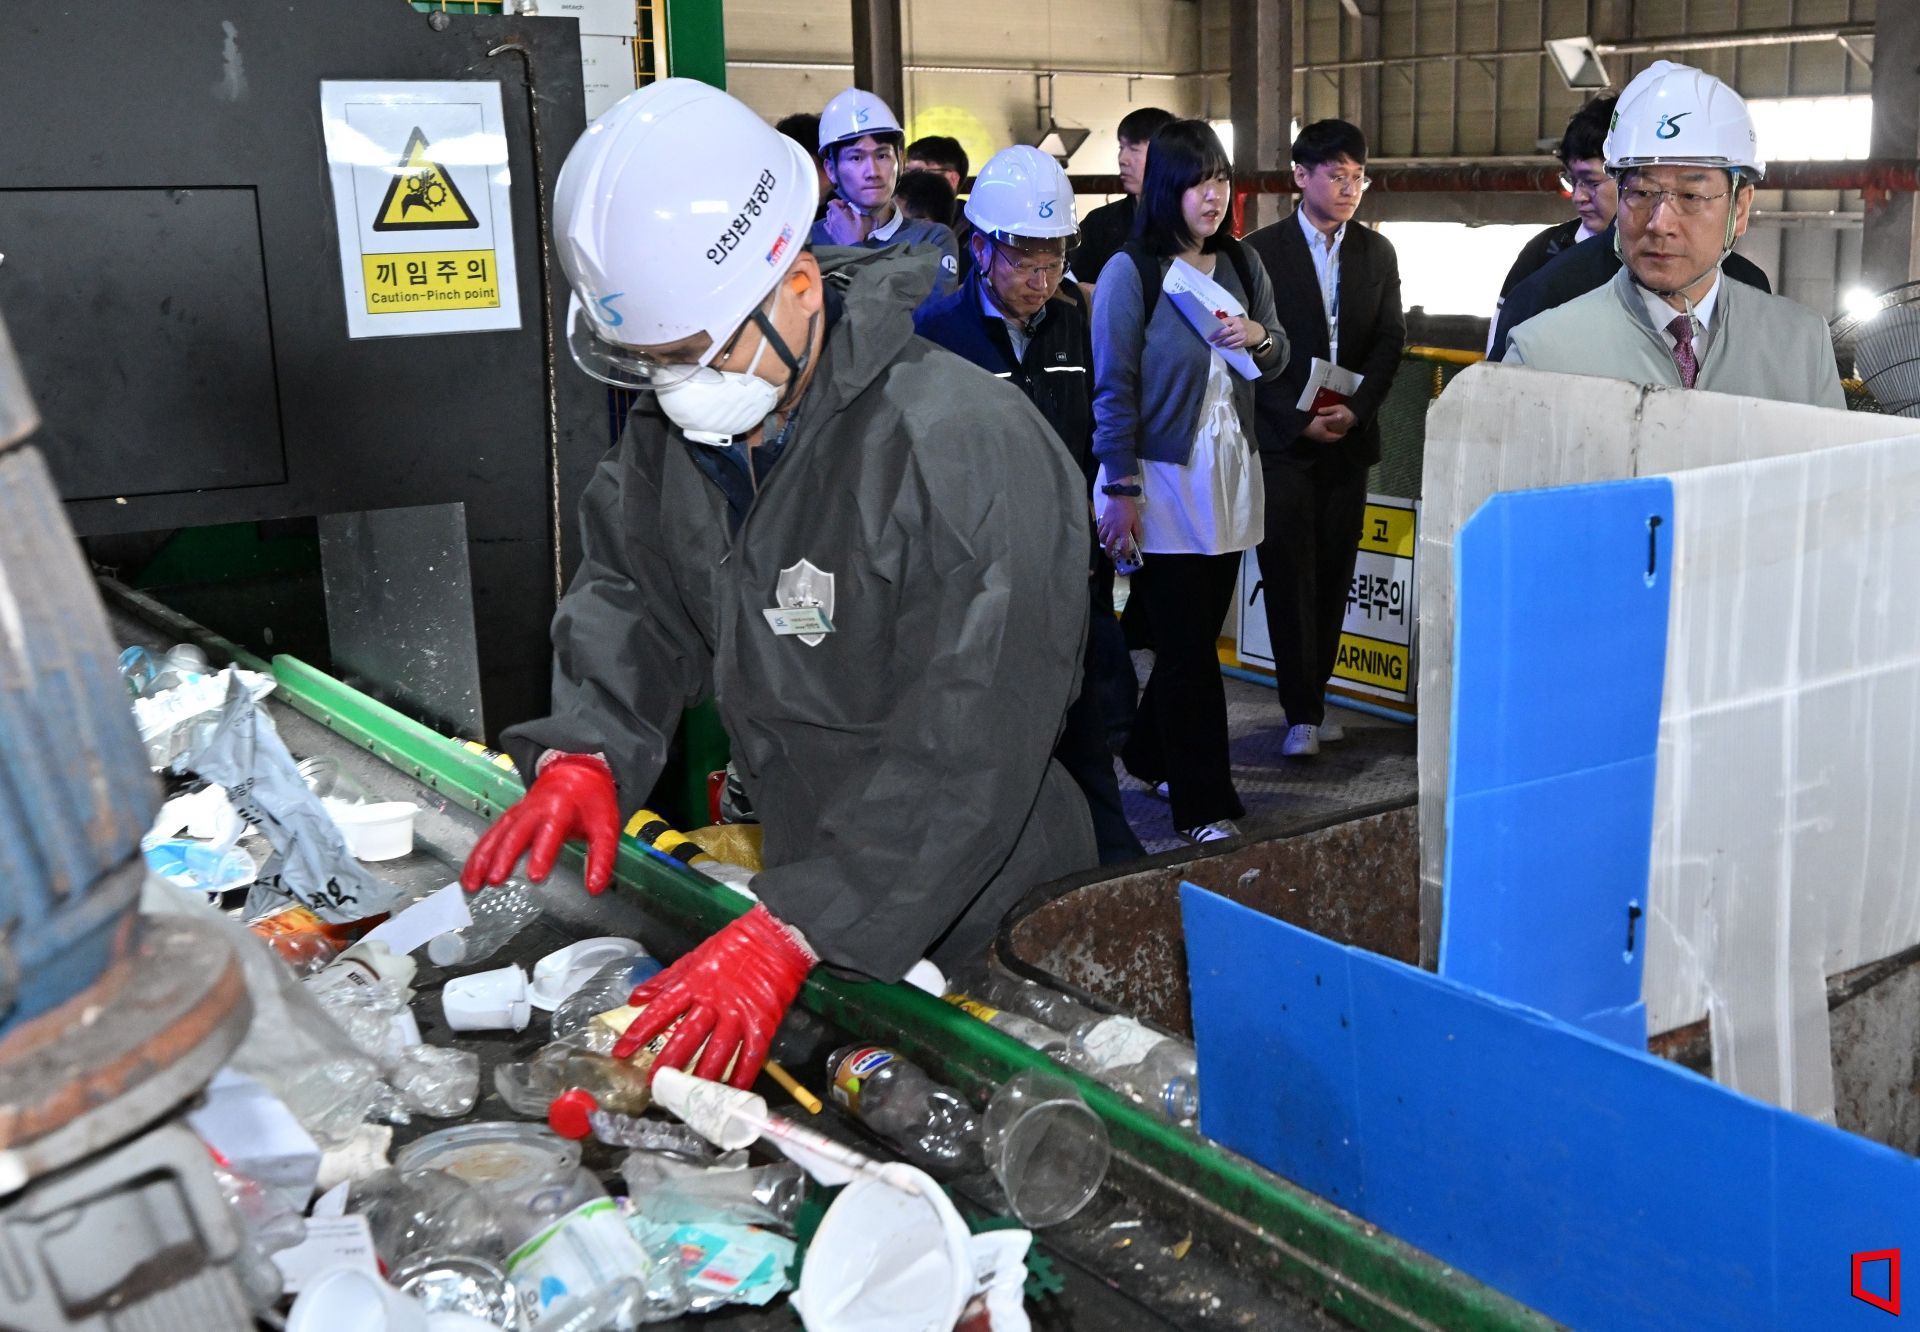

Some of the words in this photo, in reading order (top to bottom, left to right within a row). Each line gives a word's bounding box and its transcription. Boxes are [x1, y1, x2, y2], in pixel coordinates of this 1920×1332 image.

[706, 168, 777, 265] 인천환경공단
[376, 258, 487, 286] 끼임주의
[370, 290, 461, 304] Caution-Pinch
[464, 287, 495, 301] point
[1371, 518, 1389, 543] 고
[1336, 643, 1403, 681] ARNING
